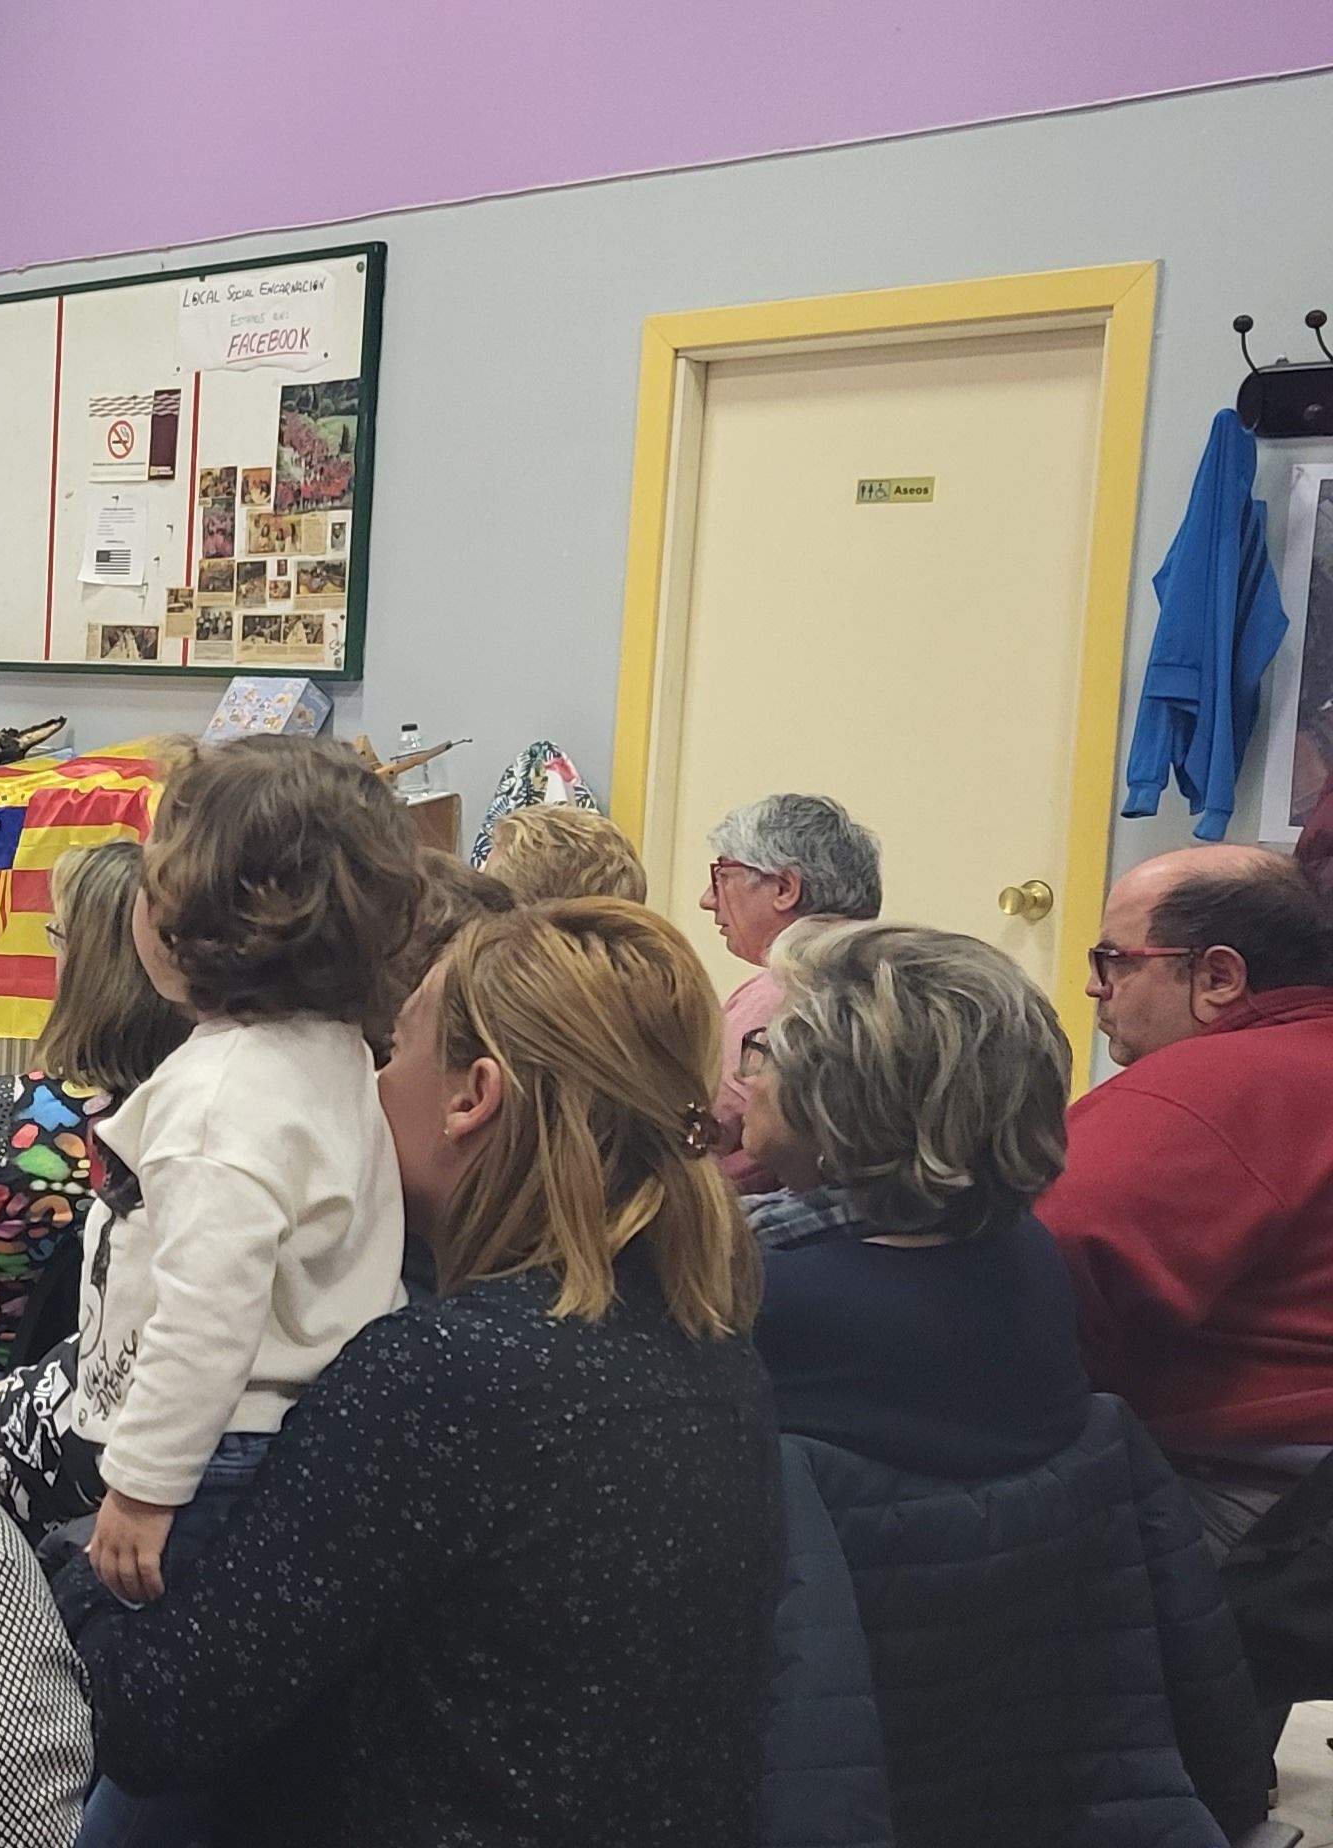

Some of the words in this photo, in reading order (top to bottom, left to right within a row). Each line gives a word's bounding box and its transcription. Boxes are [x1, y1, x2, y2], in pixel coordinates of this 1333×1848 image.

[183, 288, 220, 308] LOCAL
[227, 327, 311, 358] FACEBOOK
[894, 485, 929, 495] Aseos
